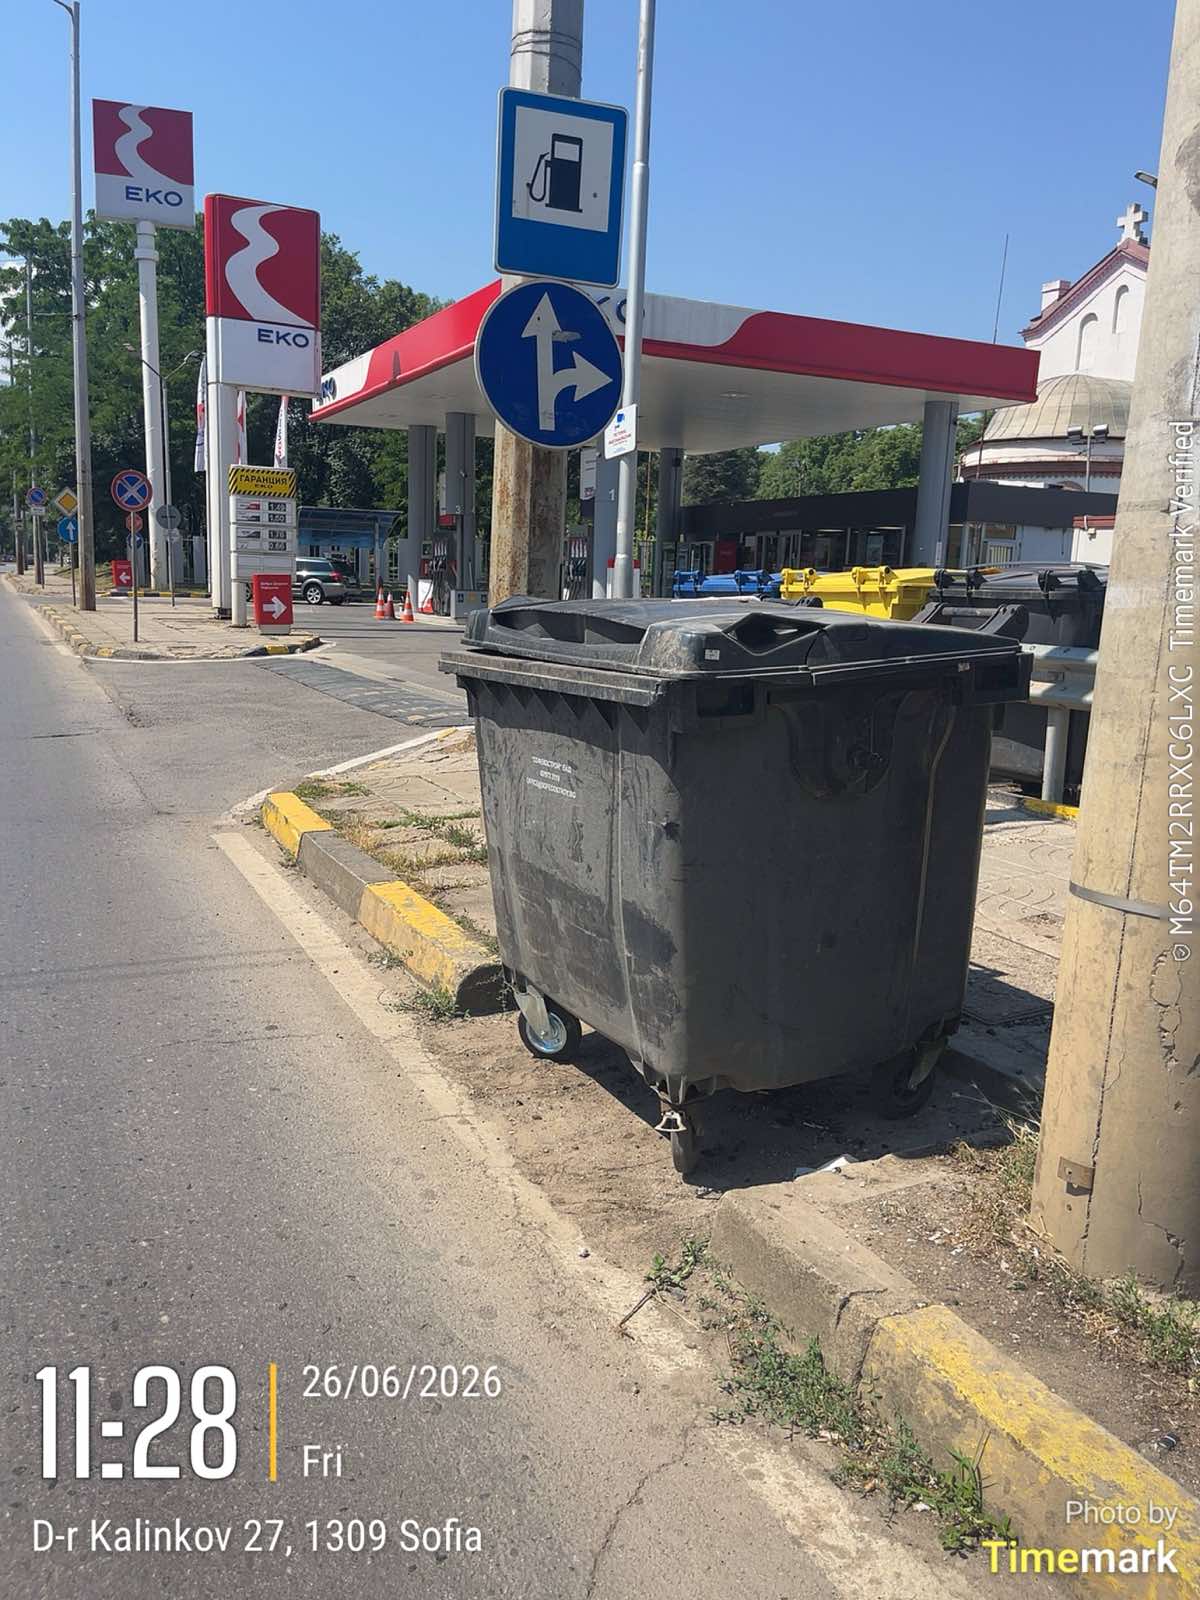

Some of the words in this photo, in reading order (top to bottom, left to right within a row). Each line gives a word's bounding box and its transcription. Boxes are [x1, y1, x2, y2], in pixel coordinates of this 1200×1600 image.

[125, 185, 183, 207] EKO
[257, 328, 310, 348] EKO
[239, 475, 287, 485] ГАРАНЦИЯ
[609, 488, 615, 501] 1
